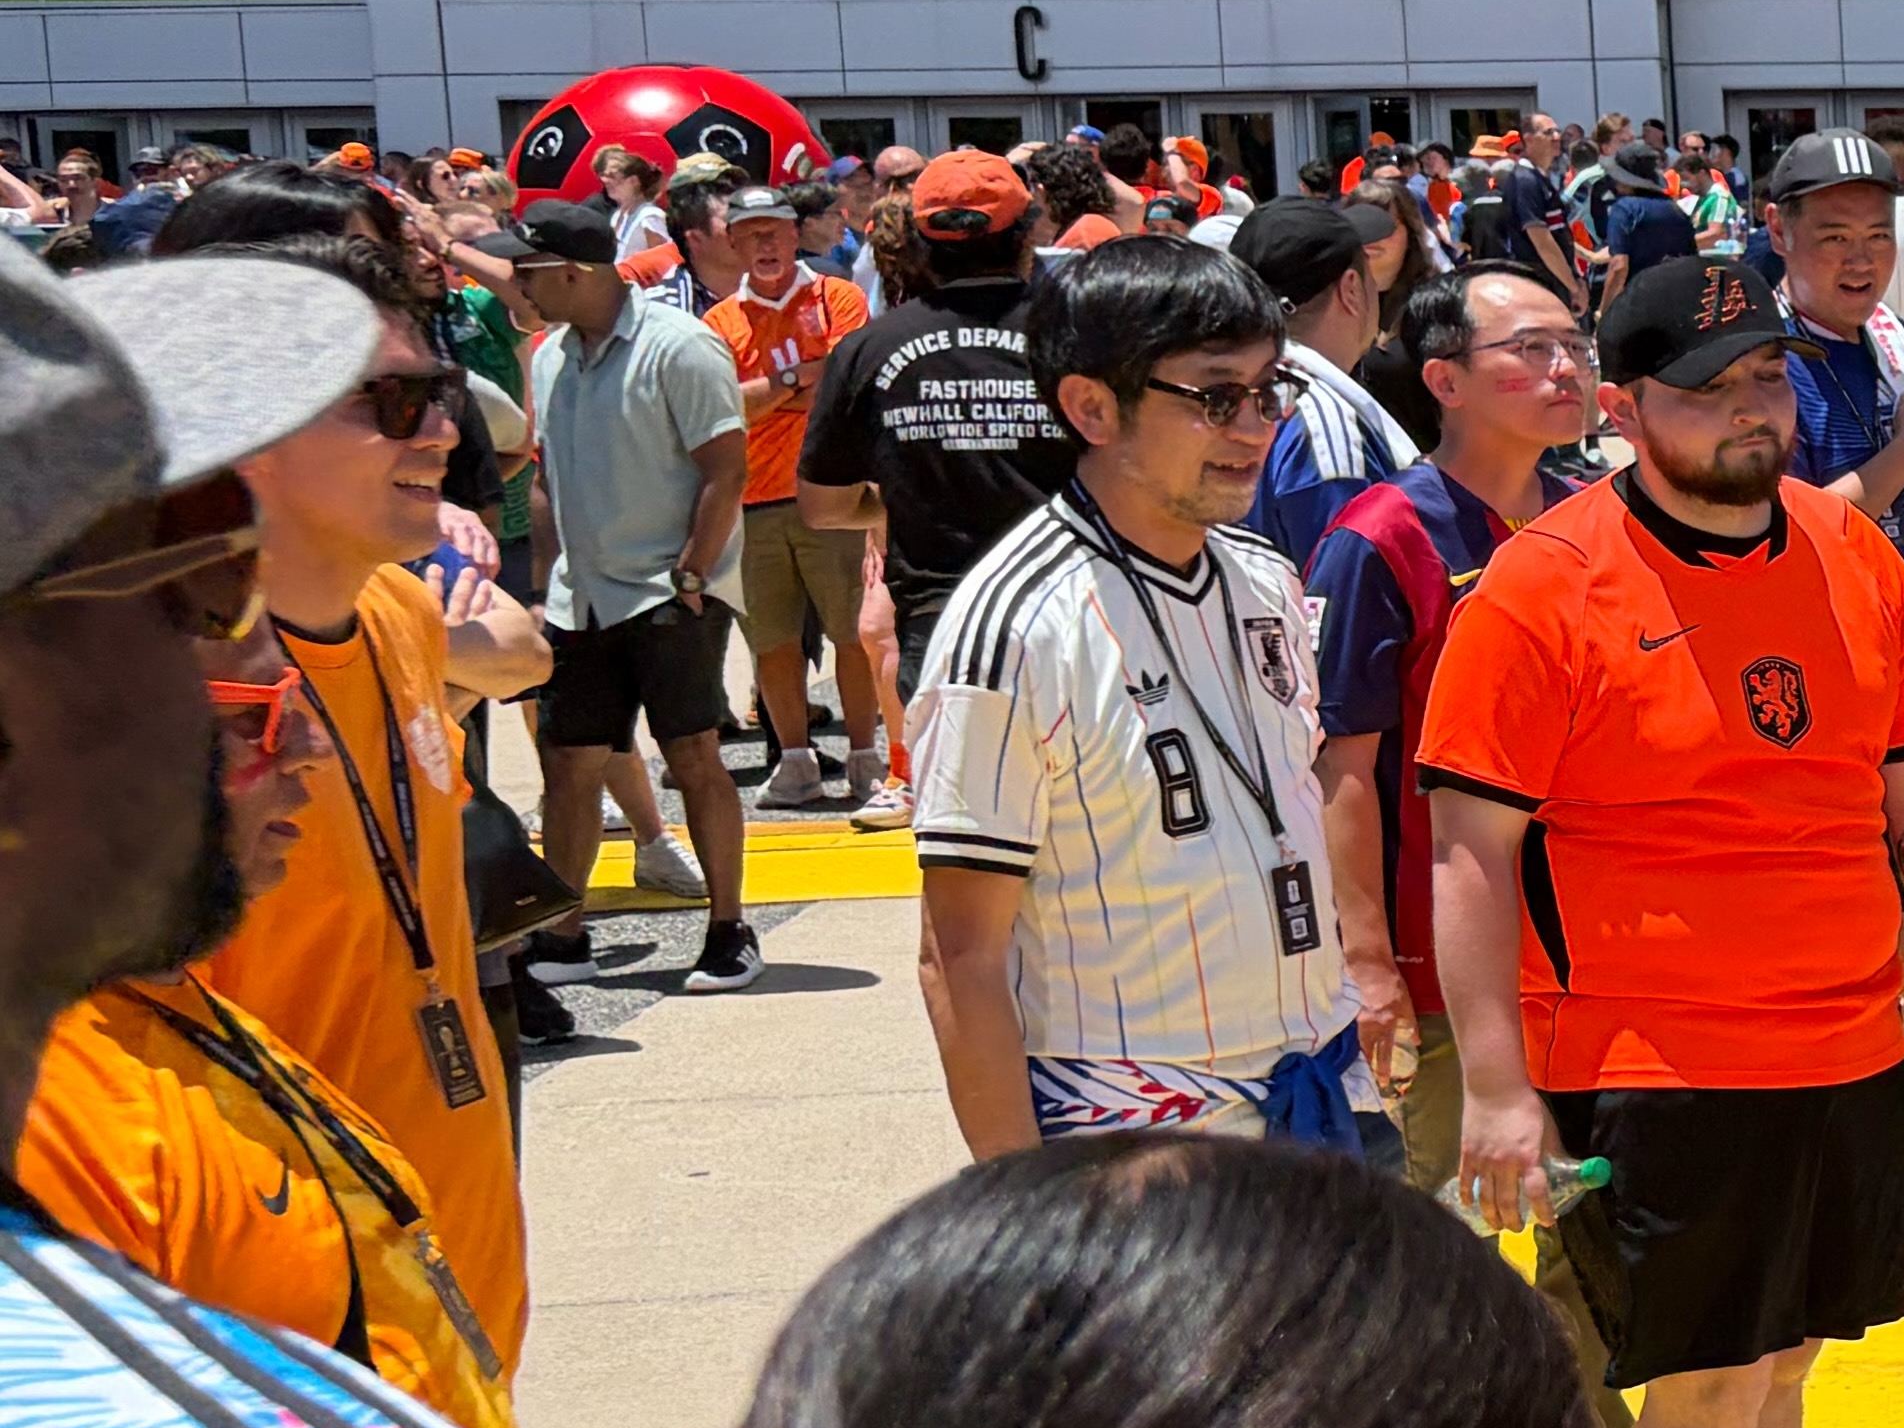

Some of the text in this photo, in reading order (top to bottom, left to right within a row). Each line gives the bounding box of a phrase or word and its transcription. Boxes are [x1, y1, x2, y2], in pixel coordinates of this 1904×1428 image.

[1014, 5, 1047, 84] C
[875, 327, 1028, 392] SERVICE DEPAR
[918, 378, 1038, 400] FASTHOUSE
[883, 403, 1054, 427] NEWHALL CALIFOR
[896, 422, 985, 441] WORLDWIDE
[988, 423, 1036, 438] SPEED
[1146, 727, 1215, 841] 8
